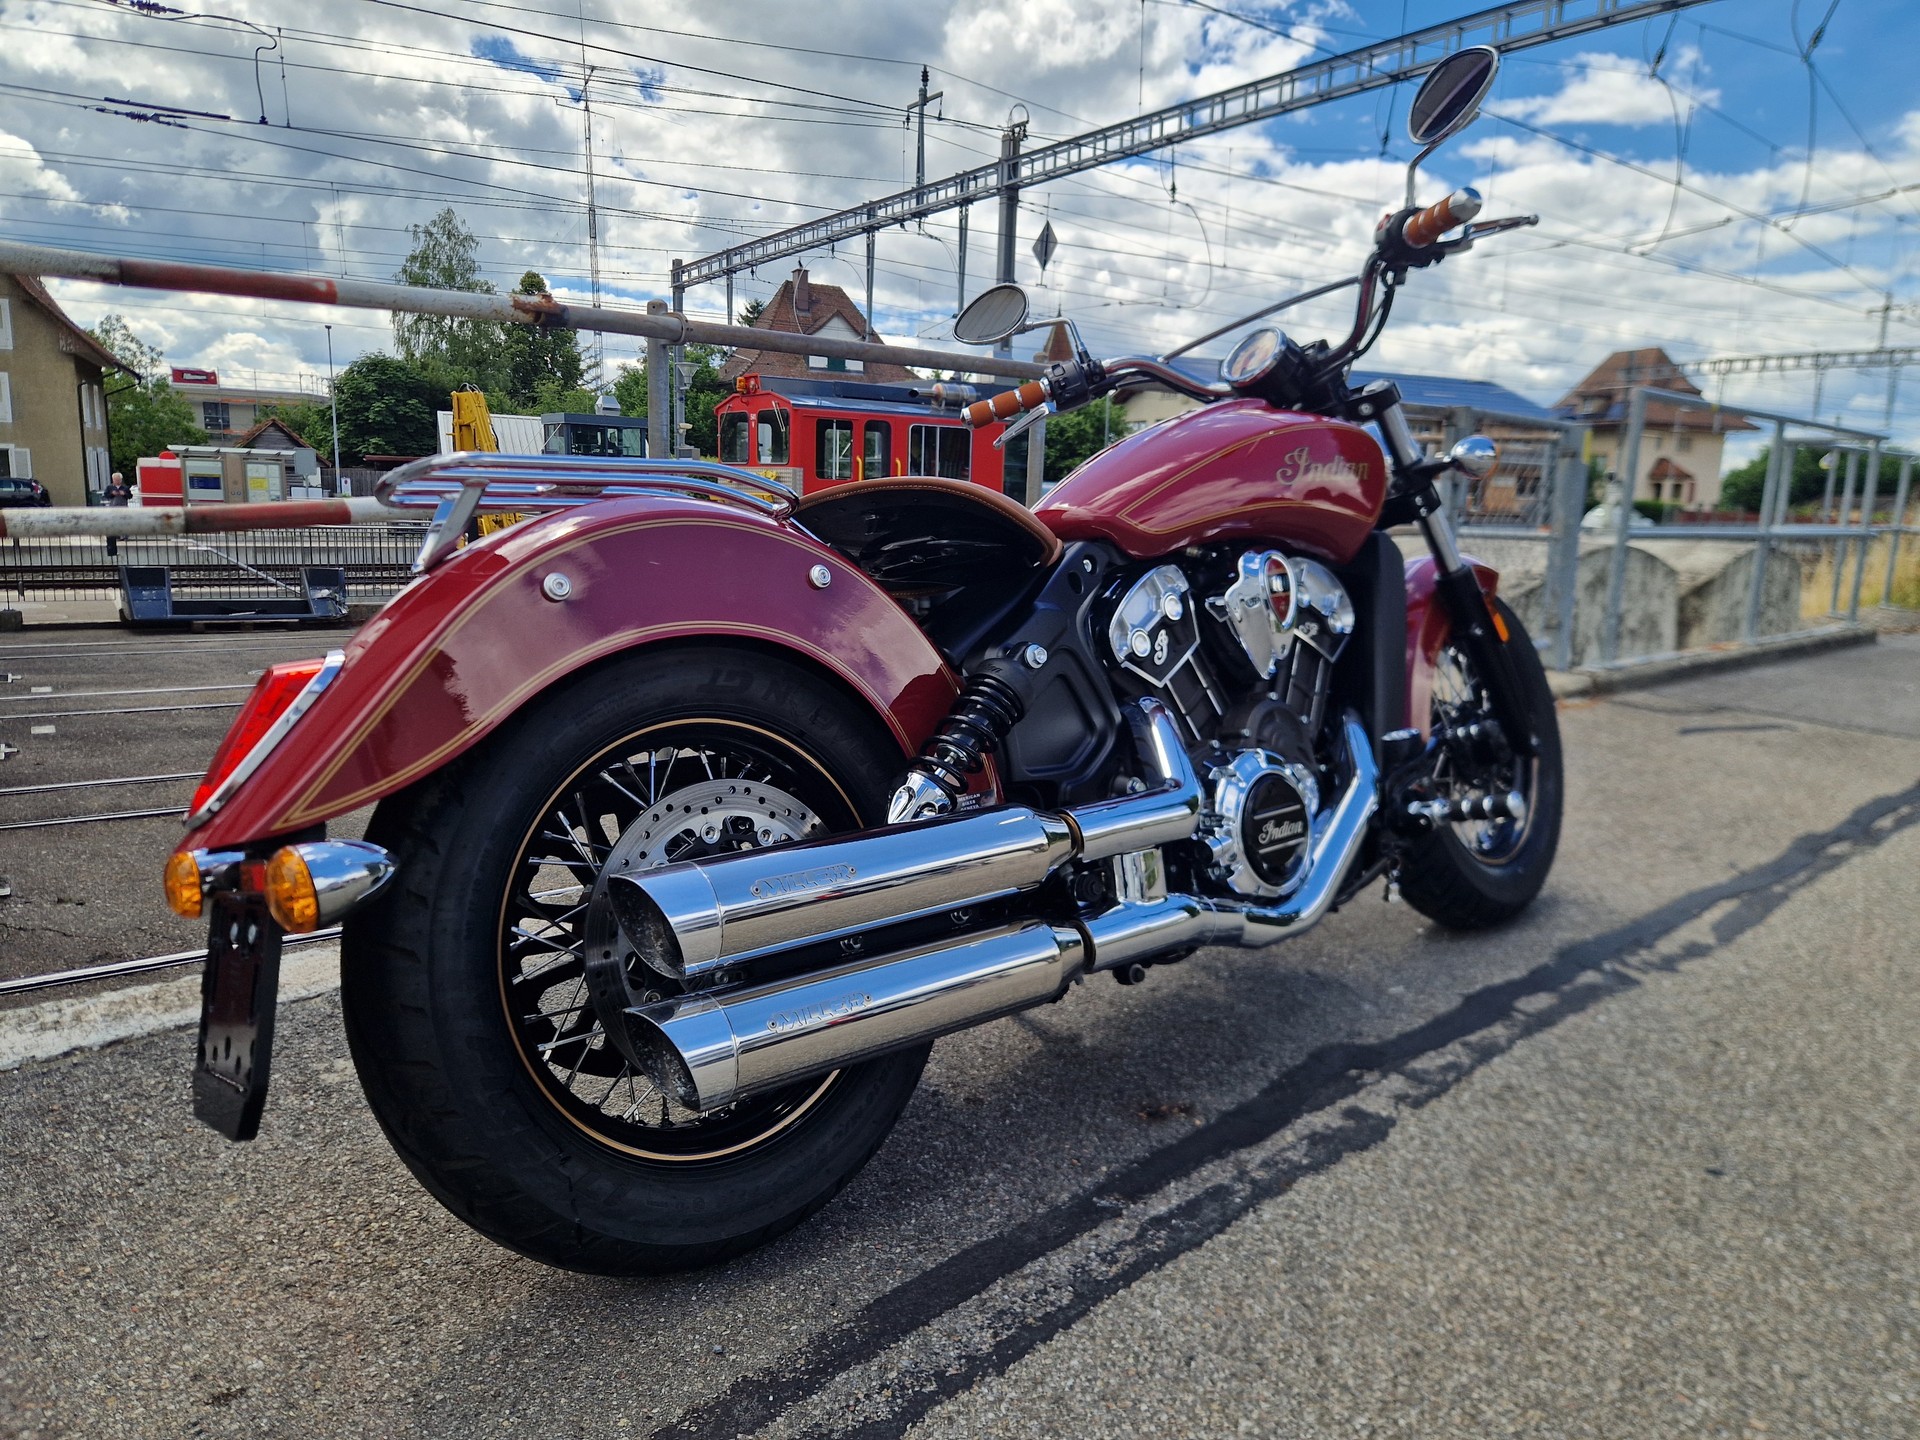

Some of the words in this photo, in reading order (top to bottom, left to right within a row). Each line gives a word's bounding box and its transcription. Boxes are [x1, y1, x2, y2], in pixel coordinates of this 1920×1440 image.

[1276, 447, 1369, 486] Indian
[1258, 820, 1304, 844] Indian
[758, 863, 851, 899] MILLER
[775, 992, 866, 1031] MILLER
